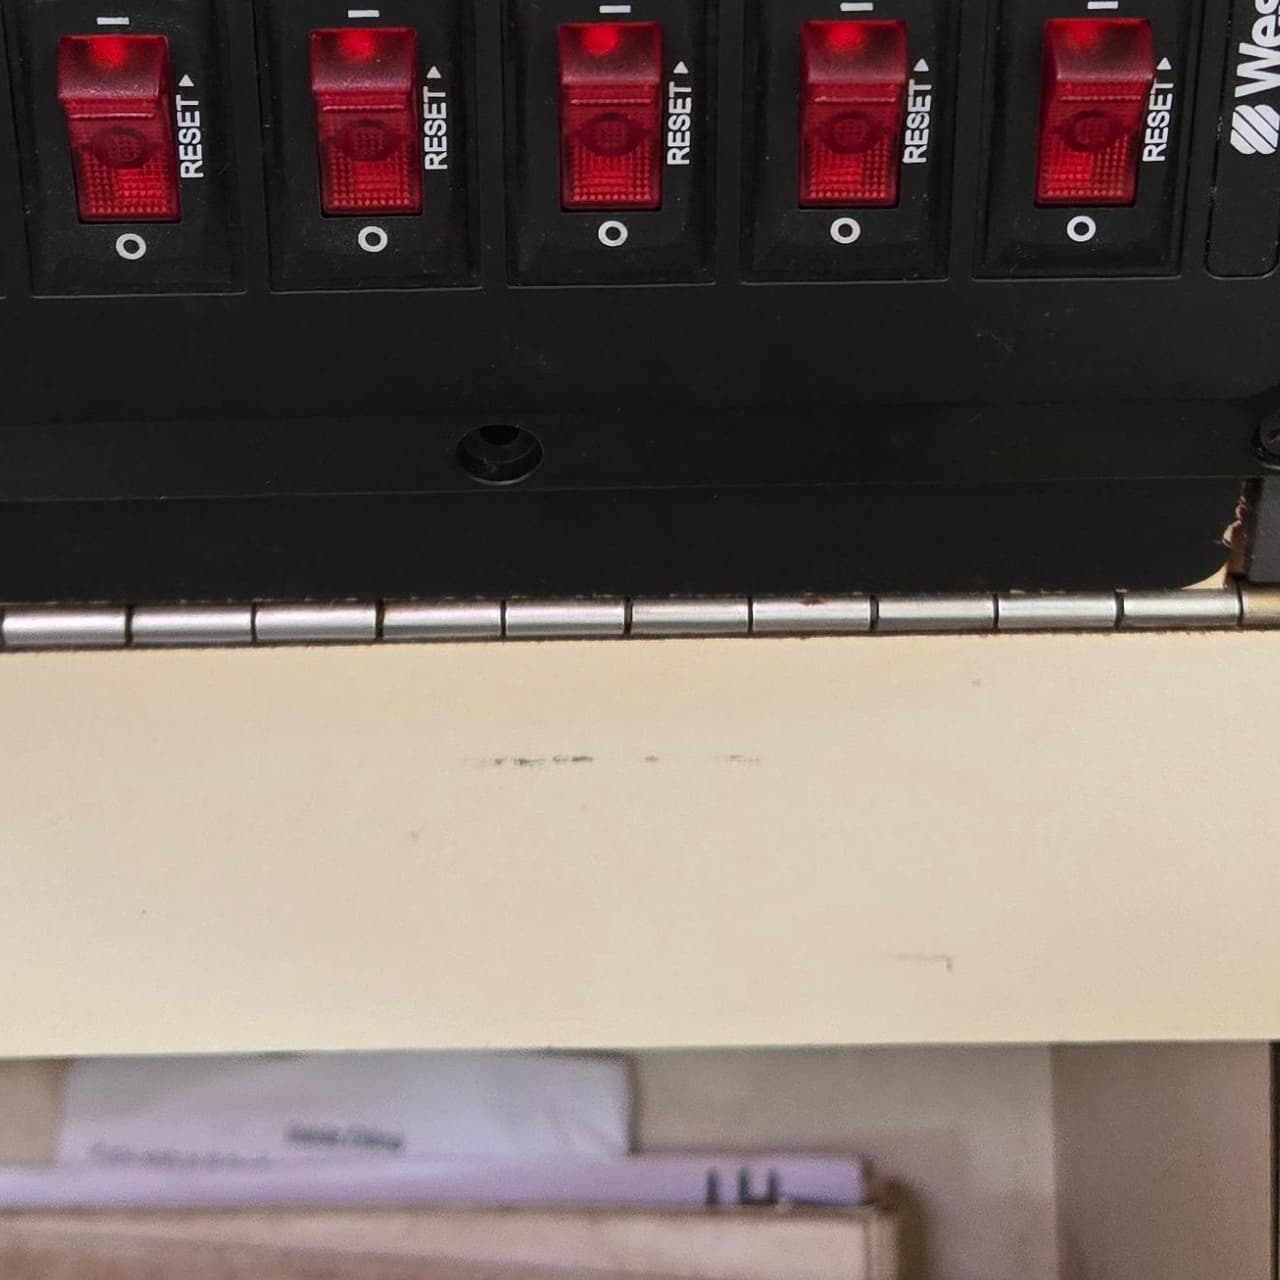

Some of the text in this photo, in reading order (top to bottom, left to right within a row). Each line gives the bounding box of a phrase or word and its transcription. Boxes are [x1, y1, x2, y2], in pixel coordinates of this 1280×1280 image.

[174, 93, 205, 179] RESET
[422, 84, 450, 171] RESET
[666, 81, 692, 165] RESET
[902, 77, 933, 164] RESET
[1141, 78, 1175, 163] RESET
